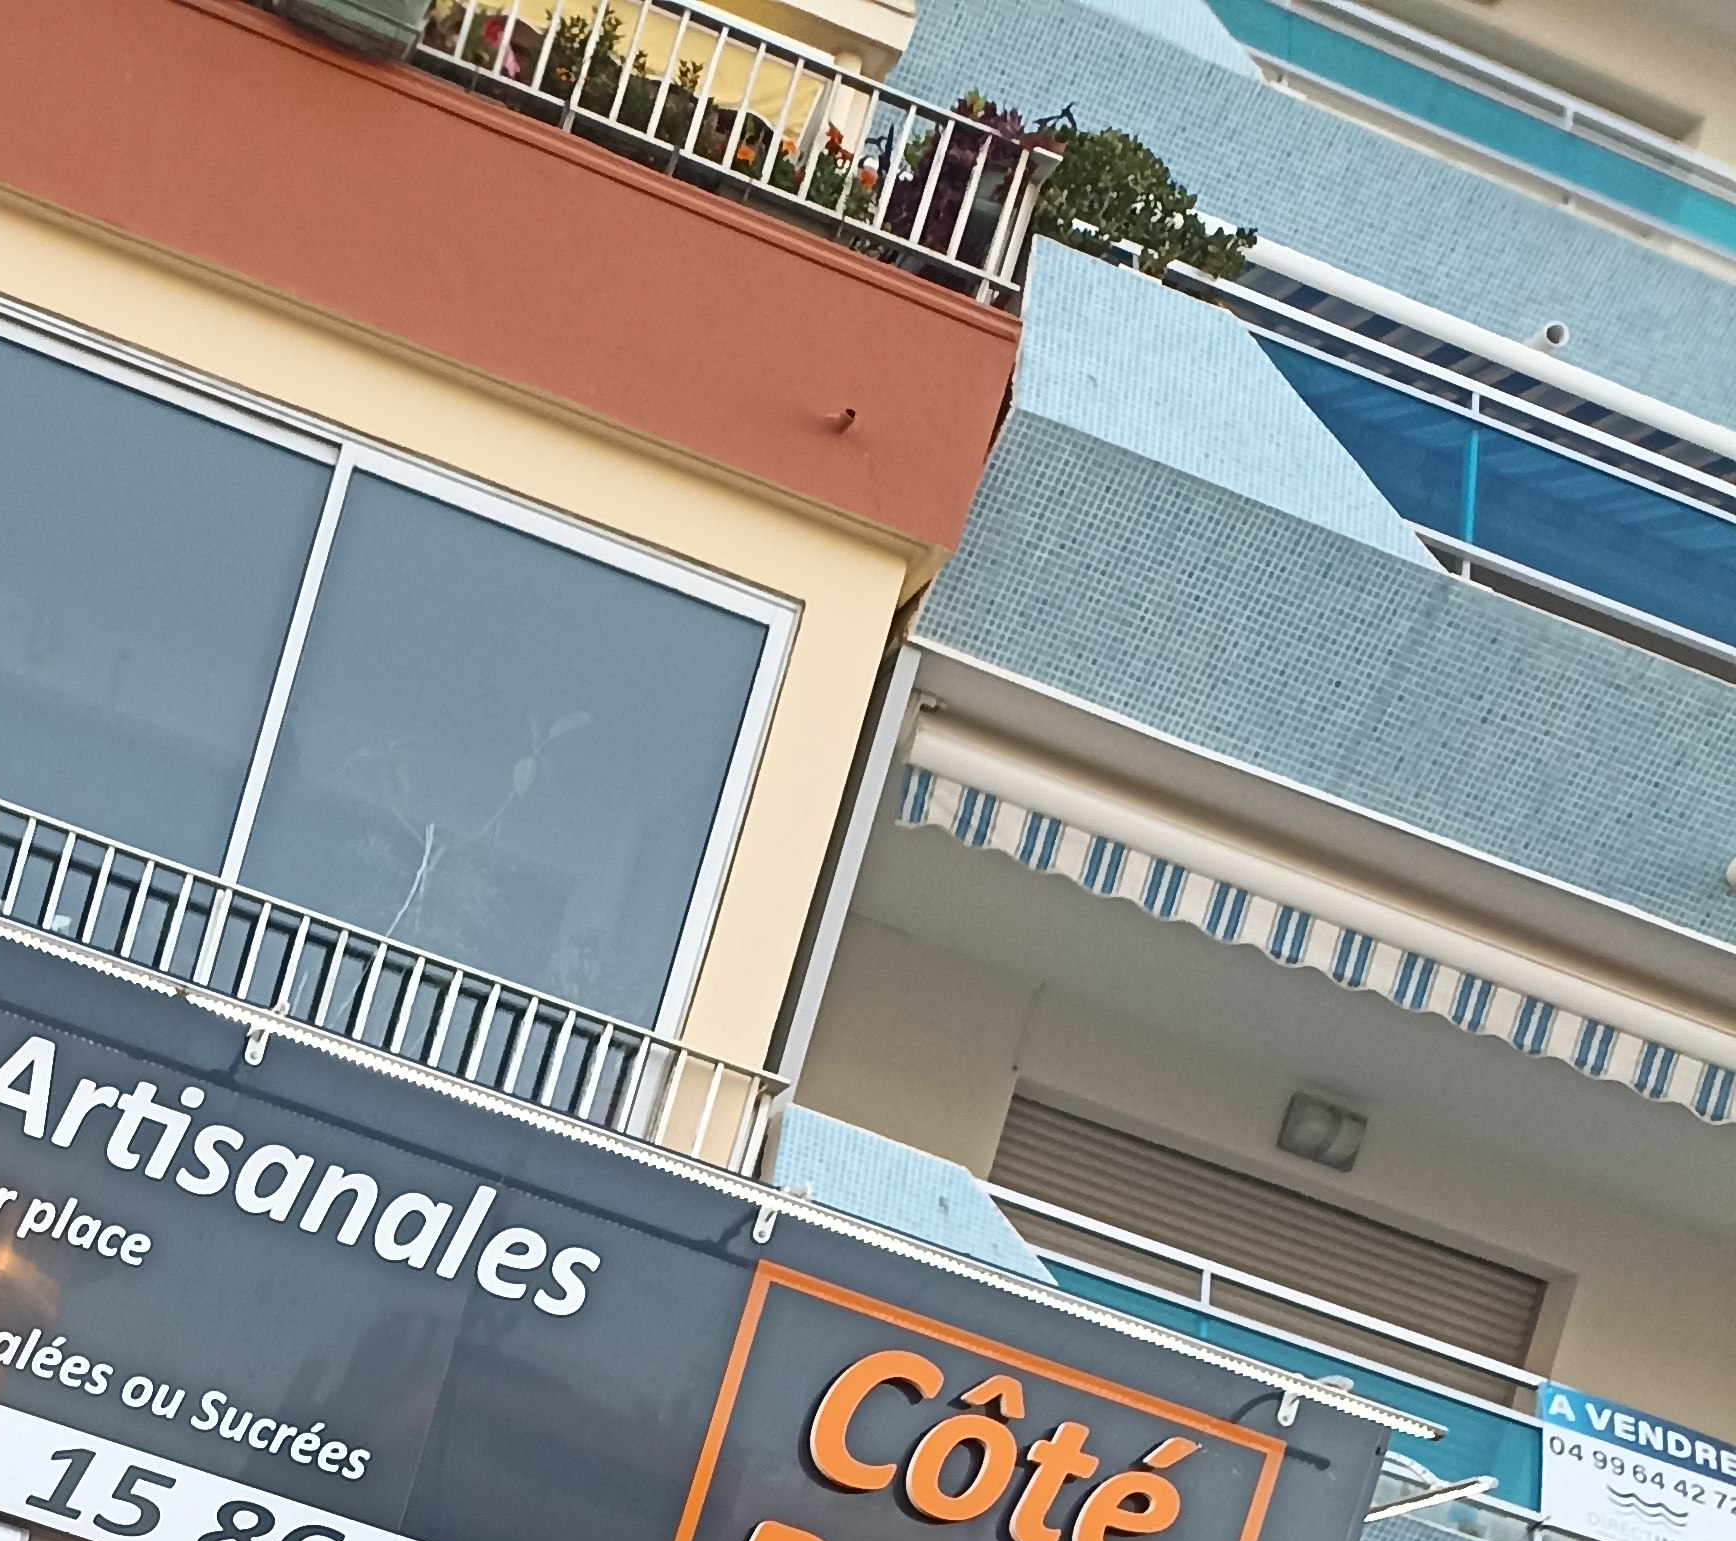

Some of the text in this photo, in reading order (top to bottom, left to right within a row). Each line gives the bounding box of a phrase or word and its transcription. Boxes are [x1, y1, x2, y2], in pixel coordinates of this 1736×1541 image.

[15, 1193, 153, 1269] place
[120, 1369, 189, 1422] ou
[190, 1388, 372, 1483] Sucrées
[1549, 1393, 1736, 1478] A VENDRE
[24, 1446, 178, 1538] 15
[1549, 1436, 1583, 1461] 04
[1592, 1450, 1625, 1476] 99
[1632, 1464, 1665, 1489] 64
[1673, 1479, 1706, 1505] 42
